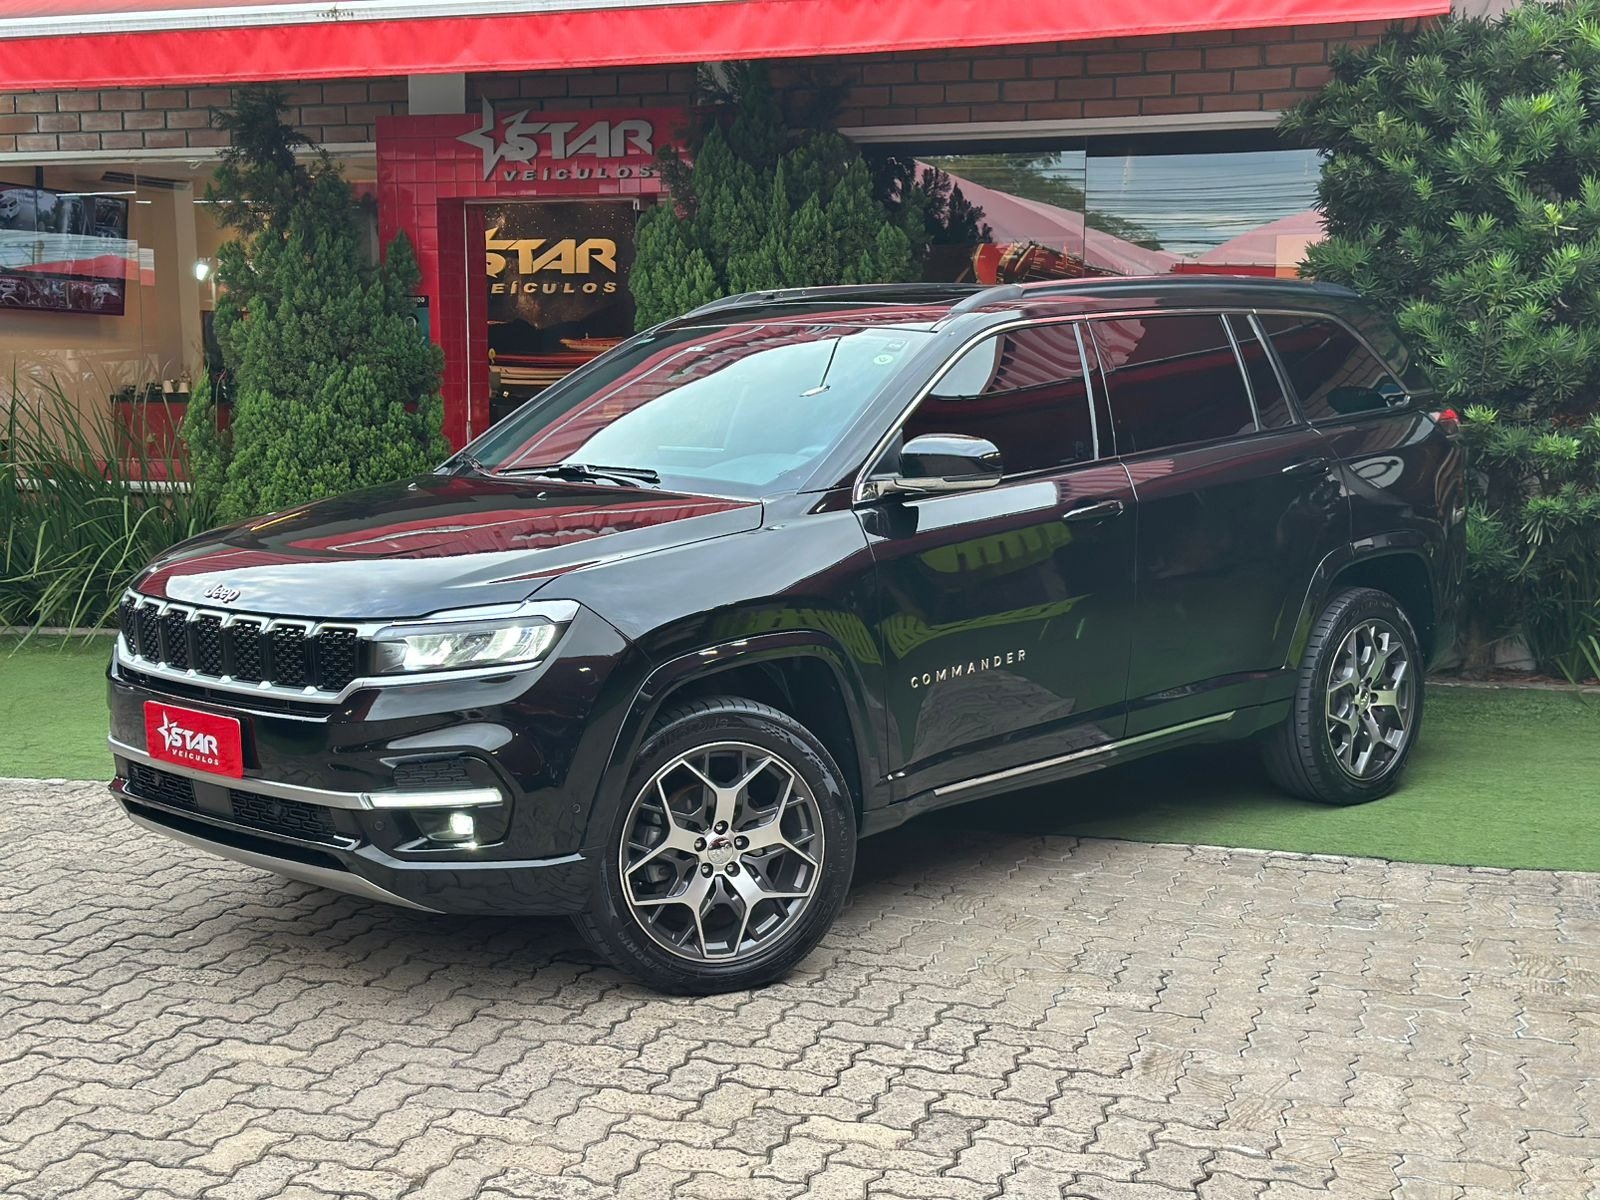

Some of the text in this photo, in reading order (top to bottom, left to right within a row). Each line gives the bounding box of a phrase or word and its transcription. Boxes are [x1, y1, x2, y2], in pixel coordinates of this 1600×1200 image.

[502, 108, 654, 165] STAR
[490, 280, 617, 295] EÍCULOS
[204, 583, 241, 604] Jeep
[910, 649, 1027, 689] COMMANDER
[168, 721, 219, 756] STAR
